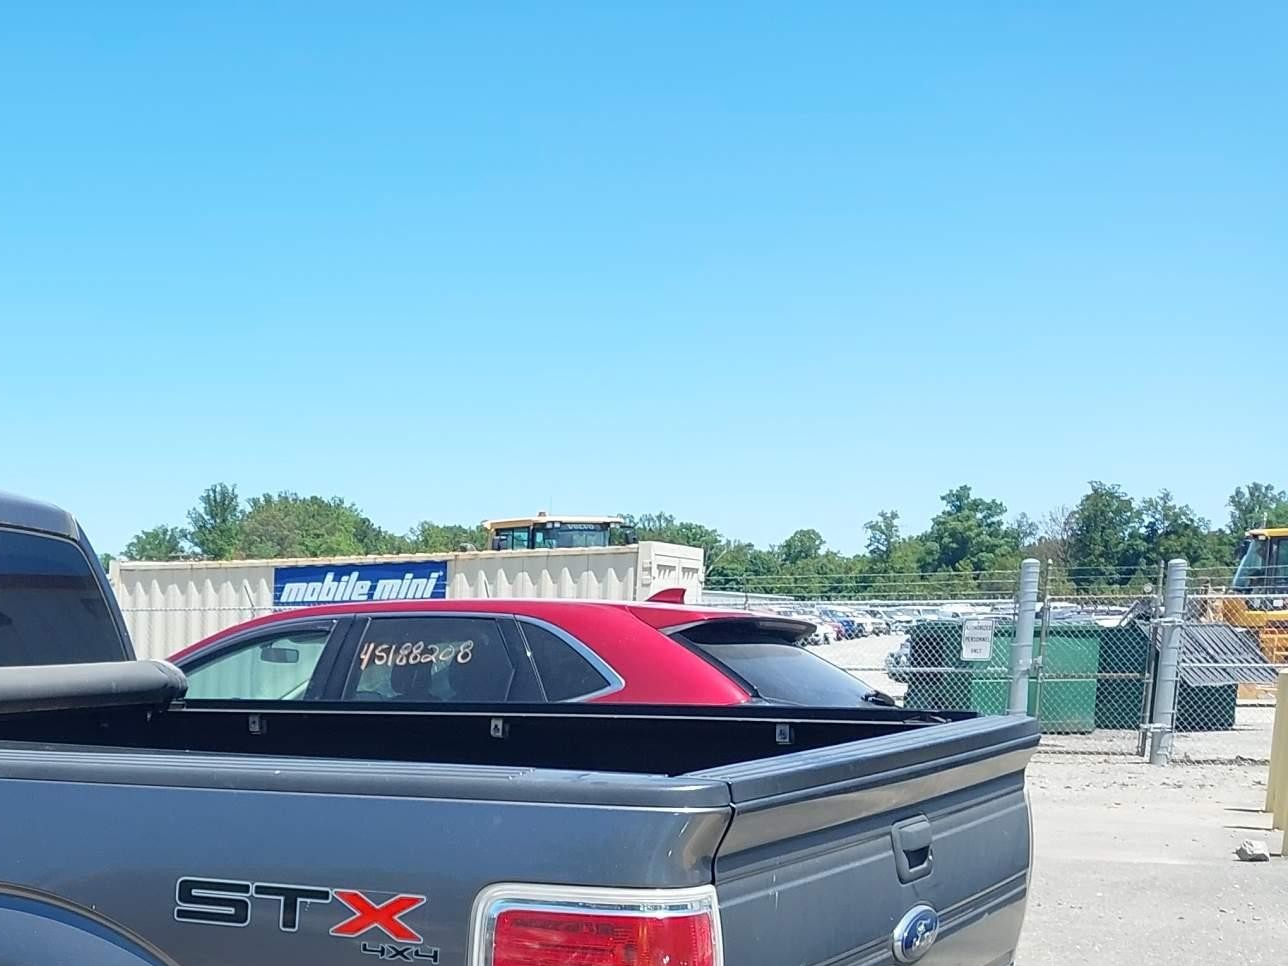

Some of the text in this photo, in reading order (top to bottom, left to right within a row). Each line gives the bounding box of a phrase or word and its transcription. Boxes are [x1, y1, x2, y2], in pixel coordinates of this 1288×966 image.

[280, 571, 442, 603] mobile mini
[359, 640, 473, 671] 45188208
[174, 876, 427, 943] STX
